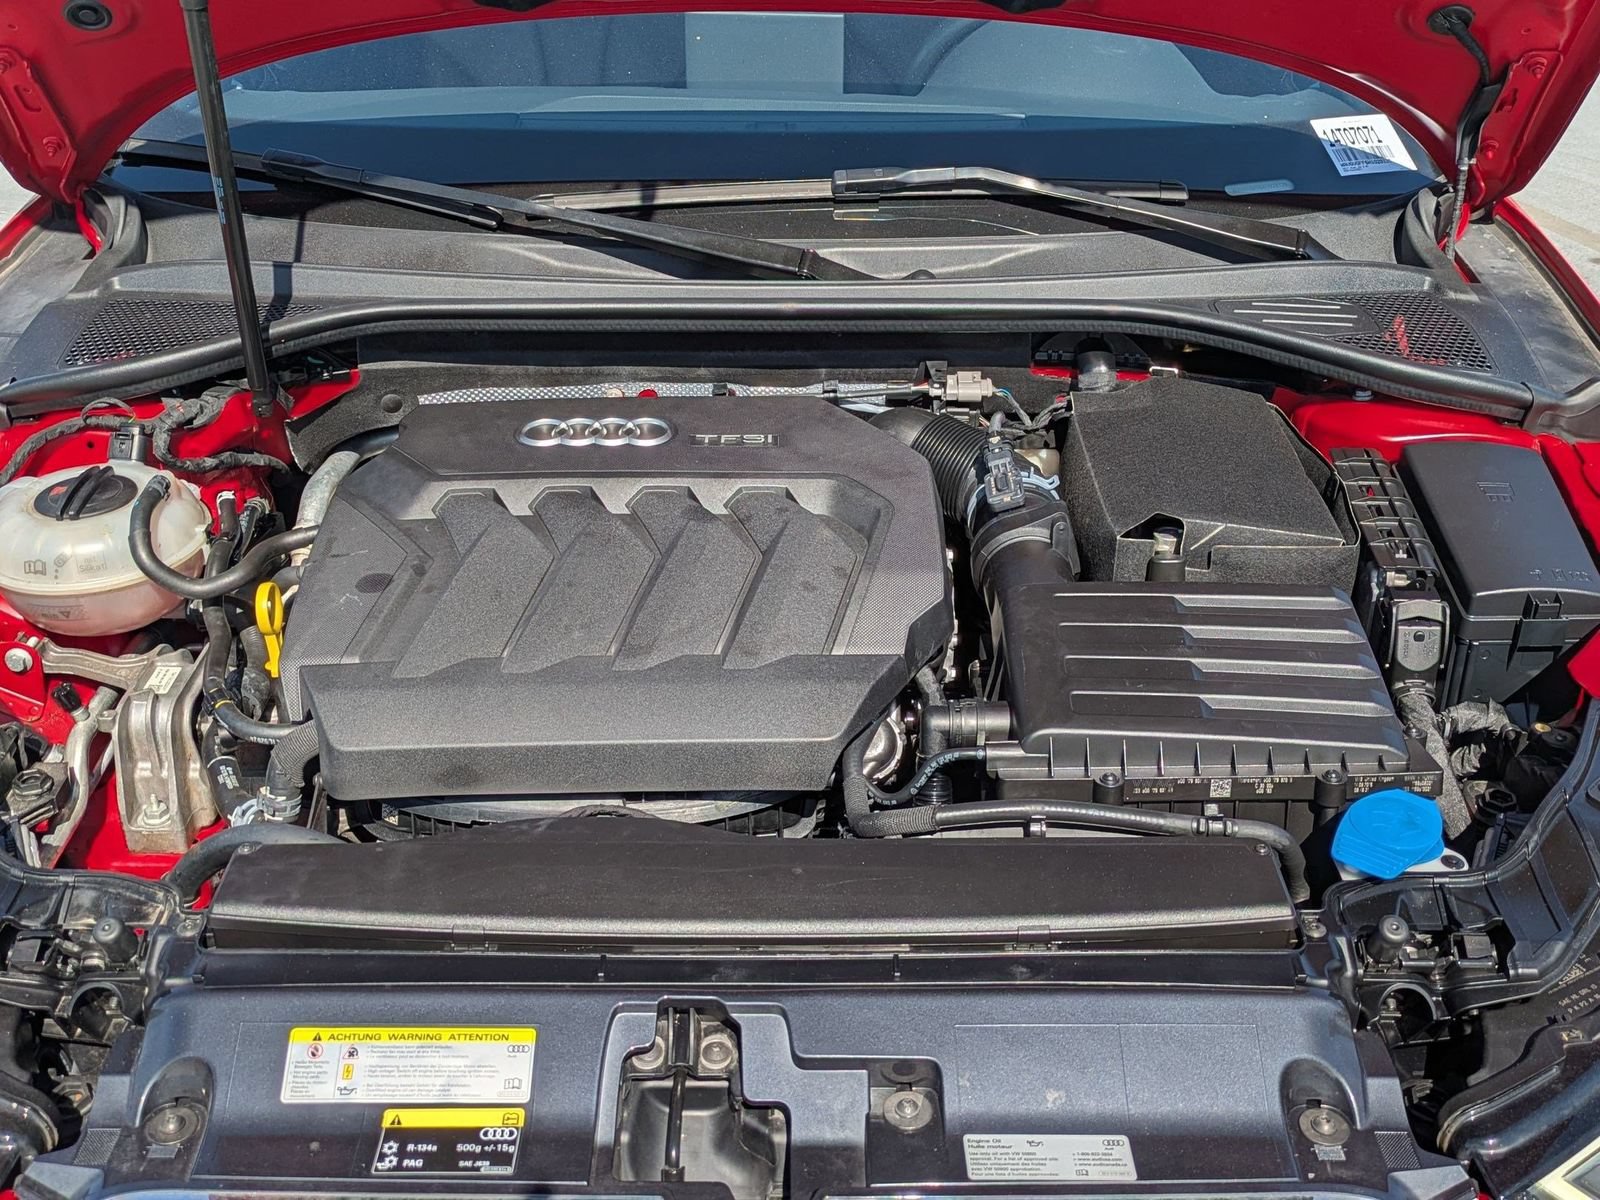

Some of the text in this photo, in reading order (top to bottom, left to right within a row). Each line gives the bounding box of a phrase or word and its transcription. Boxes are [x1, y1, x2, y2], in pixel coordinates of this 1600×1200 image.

[1322, 125, 1383, 148] 14T07071
[695, 434, 773, 445] TFSI
[327, 1032, 510, 1041] ACHTUNG WARNING ATTENTION
[406, 1143, 438, 1152] R-134a
[456, 1143, 482, 1153] 500g
[402, 1158, 424, 1168] PAG
